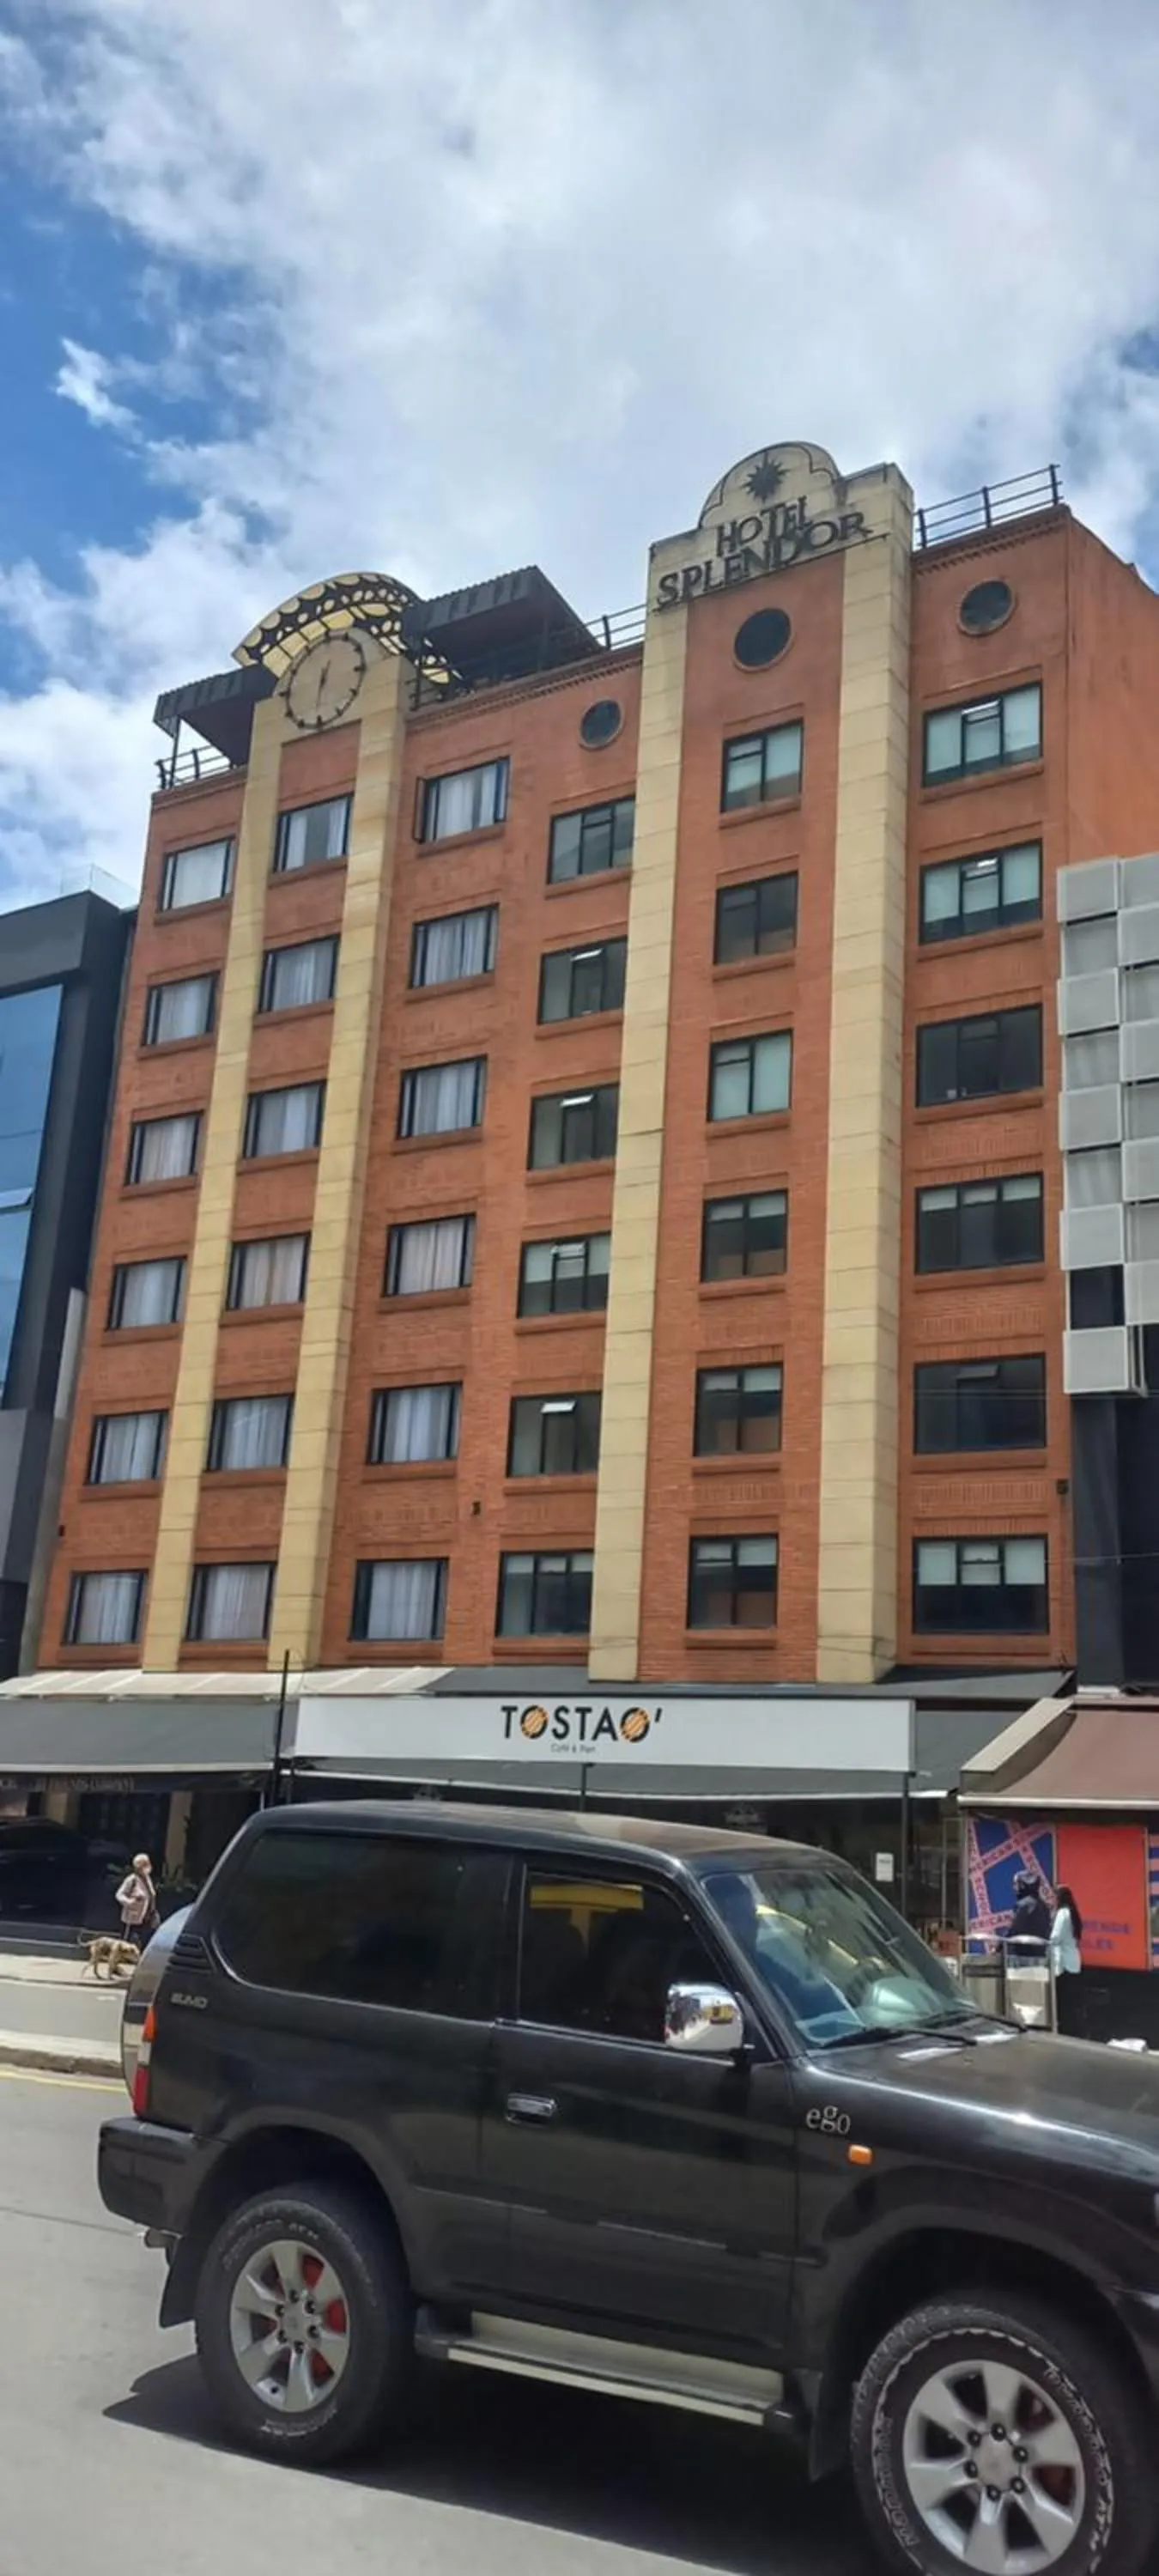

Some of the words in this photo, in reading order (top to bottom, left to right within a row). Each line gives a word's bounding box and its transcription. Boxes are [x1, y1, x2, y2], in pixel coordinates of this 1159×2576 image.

[717, 495, 812, 556] HOTEL
[656, 512, 873, 604] SPLENDOR
[806, 2105, 851, 2136] ego
